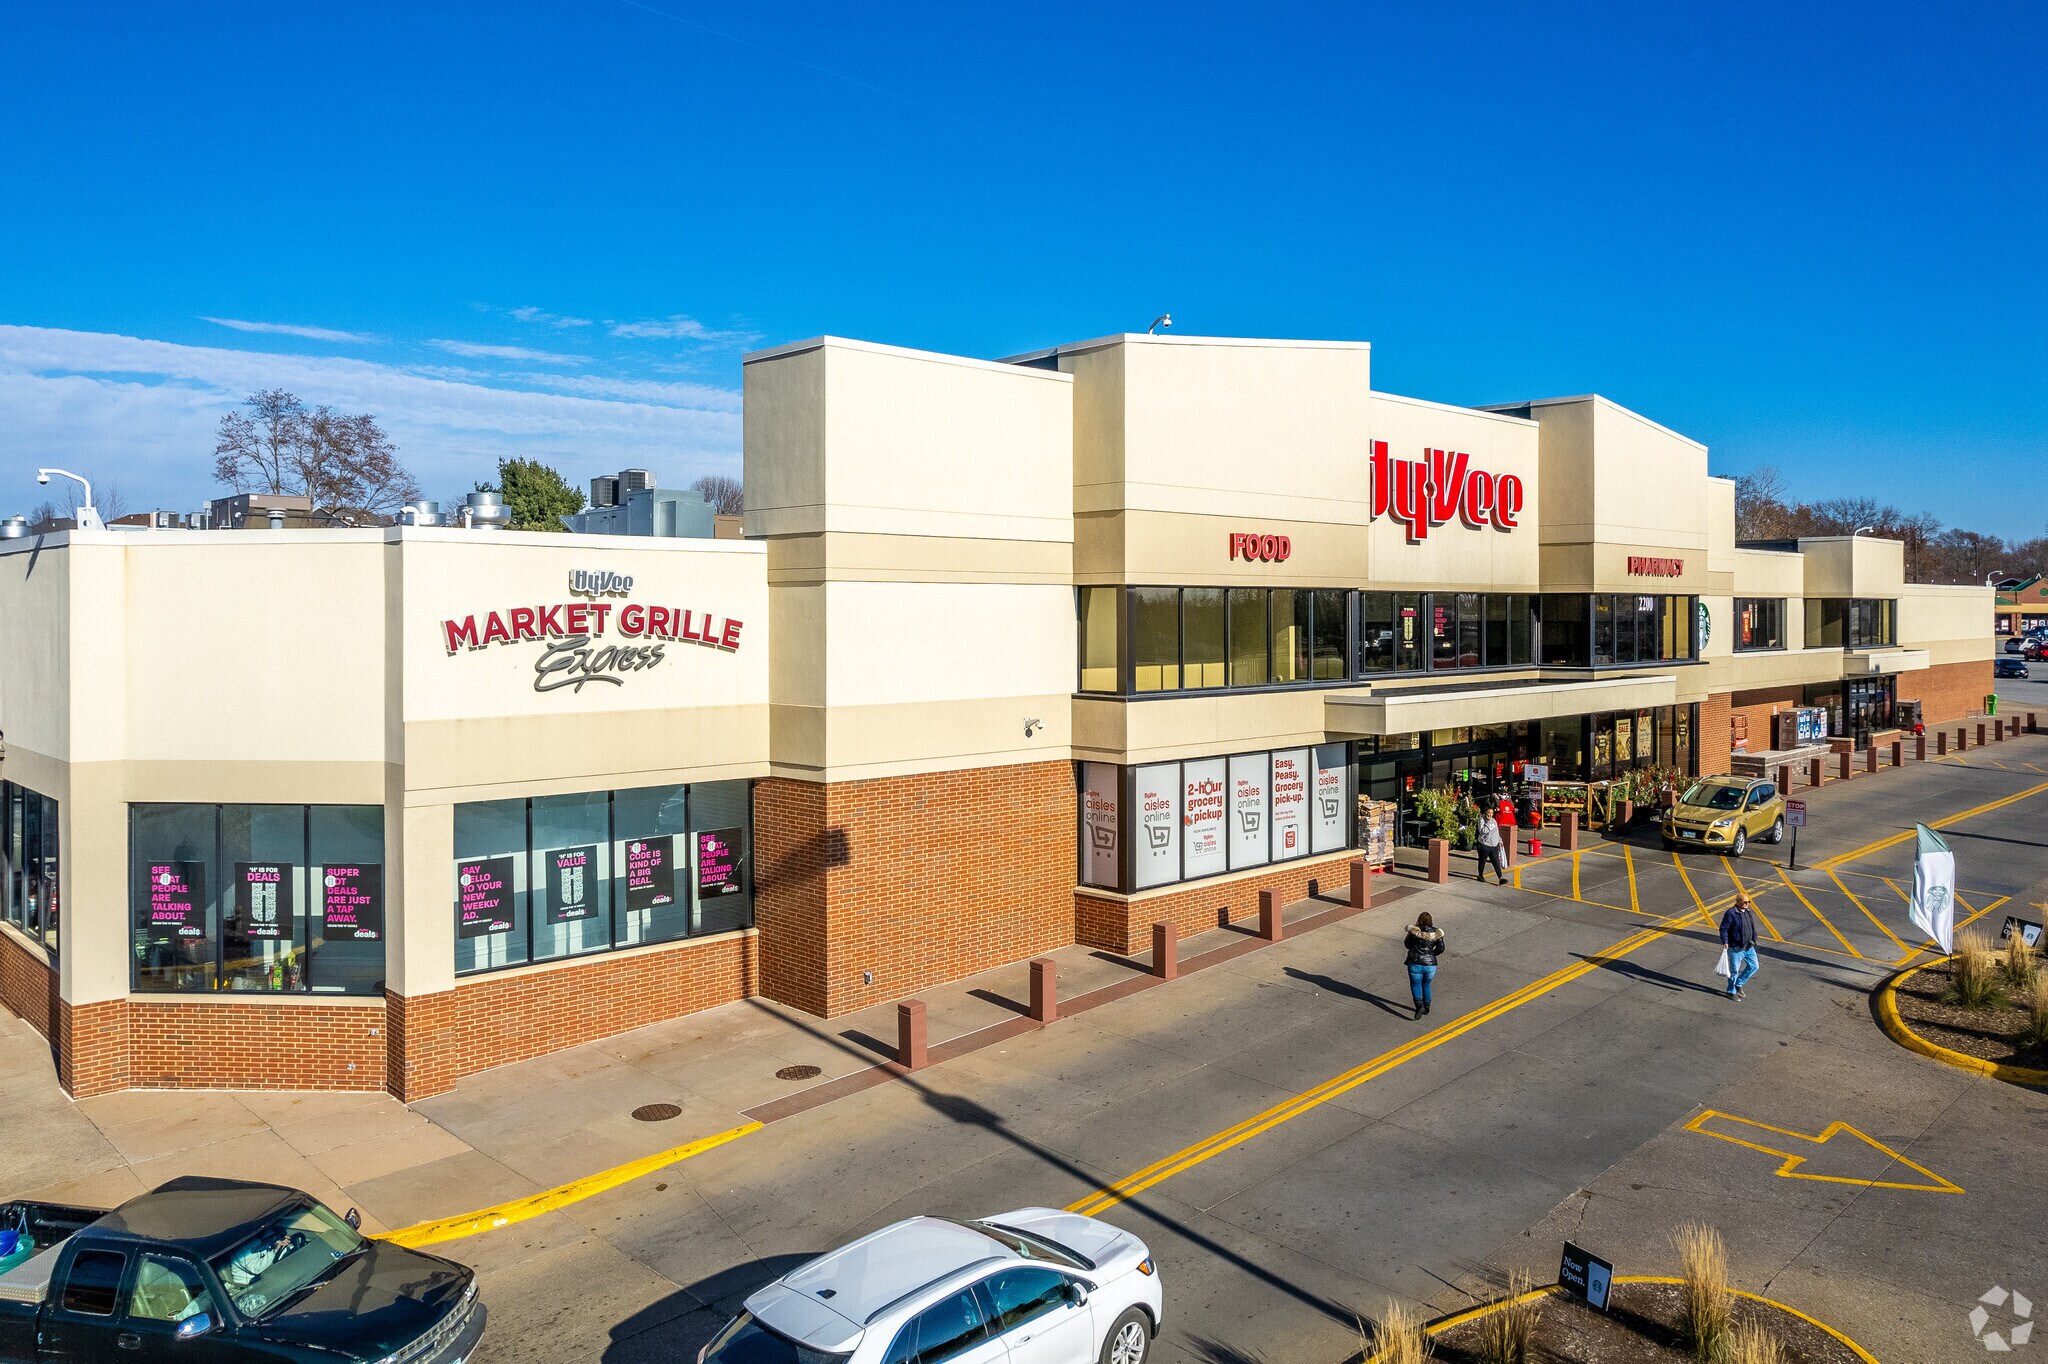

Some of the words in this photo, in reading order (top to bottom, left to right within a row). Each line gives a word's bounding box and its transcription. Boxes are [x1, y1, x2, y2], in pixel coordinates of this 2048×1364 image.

[1230, 532, 1291, 562] FOOD
[1628, 556, 1684, 577] PHARMACY
[1638, 596, 1654, 611] 2200
[442, 603, 612, 655] MARKET
[617, 604, 744, 652] GRILLE
[534, 636, 666, 693] Express
[1275, 760, 1294, 769] Easy.
[1275, 771, 1299, 780] Peasy.
[1319, 774, 1338, 786] aisles
[1275, 782, 1303, 791] Grocery
[1319, 786, 1338, 796] online
[1237, 786, 1260, 798] aisles
[1144, 798, 1170, 811] aisles
[1188, 795, 1223, 812] grocery
[1237, 798, 1261, 808] online
[1275, 793, 1304, 807] pick-up.
[1086, 799, 1115, 812] aisles
[1787, 802, 1805, 810] STOP
[1086, 811, 1116, 823] online
[1144, 811, 1170, 823] online
[1194, 809, 1223, 824] pickup
[629, 852, 651, 861] CODE
[652, 850, 661, 858] IS
[701, 849, 729, 859] PEOPLE
[557, 856, 587, 868] VALUE
[629, 860, 649, 869] KIND
[650, 858, 661, 867] OF
[701, 859, 716, 867] ARE
[151, 866, 170, 874] SEE
[327, 868, 359, 876] SUPER
[462, 865, 481, 875] SAY
[637, 868, 651, 877] BIG
[701, 865, 732, 875] TALKING
[247, 873, 280, 881] DEALS
[630, 877, 652, 886] DEAL.
[701, 873, 728, 883] ABOUT.
[151, 884, 188, 893] PEOPLE
[327, 887, 357, 895] DEALS
[463, 884, 475, 893] TO
[477, 881, 503, 891] YOUR
[151, 893, 171, 902] ARE
[327, 896, 346, 904] ARE
[348, 896, 371, 904] JUST
[463, 892, 486, 902] NEW
[151, 903, 192, 911] TALKING
[327, 905, 334, 913] A
[336, 905, 354, 913] TAP
[463, 899, 500, 911] WEEKLY
[151, 912, 186, 920] ABOUT.
[327, 914, 357, 923] AWAY.
[463, 911, 479, 920] AD.
[1564, 1256, 1583, 1273] Now
[1562, 1267, 1585, 1287] Open.
